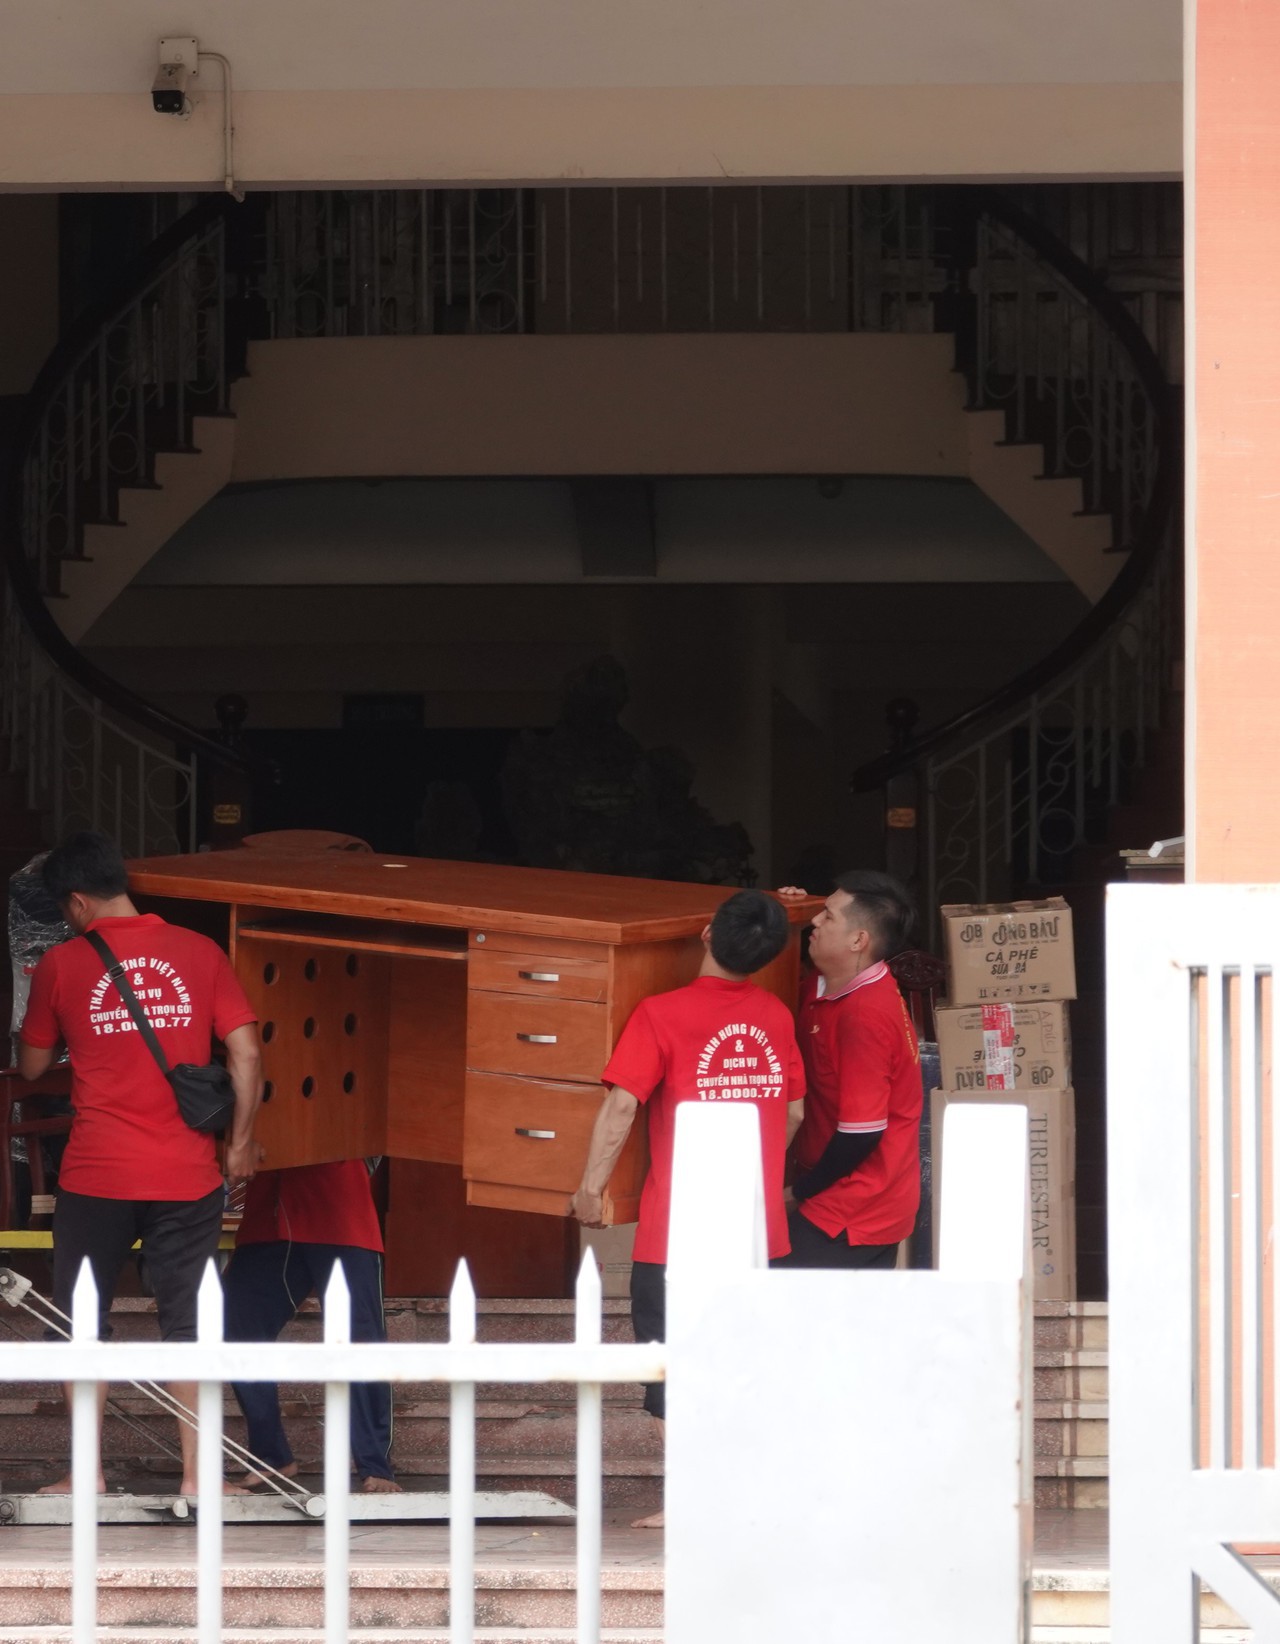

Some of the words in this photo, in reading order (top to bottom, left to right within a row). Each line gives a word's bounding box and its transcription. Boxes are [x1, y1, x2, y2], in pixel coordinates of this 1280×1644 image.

[1008, 946, 1039, 961] PHÊ
[119, 957, 147, 972] ƯNG
[149, 958, 176, 978] VIỆT
[171, 977, 191, 1004] NAM
[133, 973, 144, 985] &
[147, 988, 162, 1000] VỤ
[151, 1004, 175, 1016] TRỌN
[697, 1037, 721, 1075] THÀNH
[718, 1023, 747, 1041] HƯNG
[749, 1026, 769, 1047] VIỆT
[764, 1046, 782, 1074] NAM
[734, 1039, 744, 1052] &
[723, 1057, 745, 1070] DỊCH
[746, 1057, 758, 1069] VỤ
[730, 1074, 748, 1085] NHÀ
[749, 1075, 768, 1086] TRỌN
[698, 1087, 782, 1100] 18.0000.77
[1029, 1113, 1050, 1249] THREESTAR
